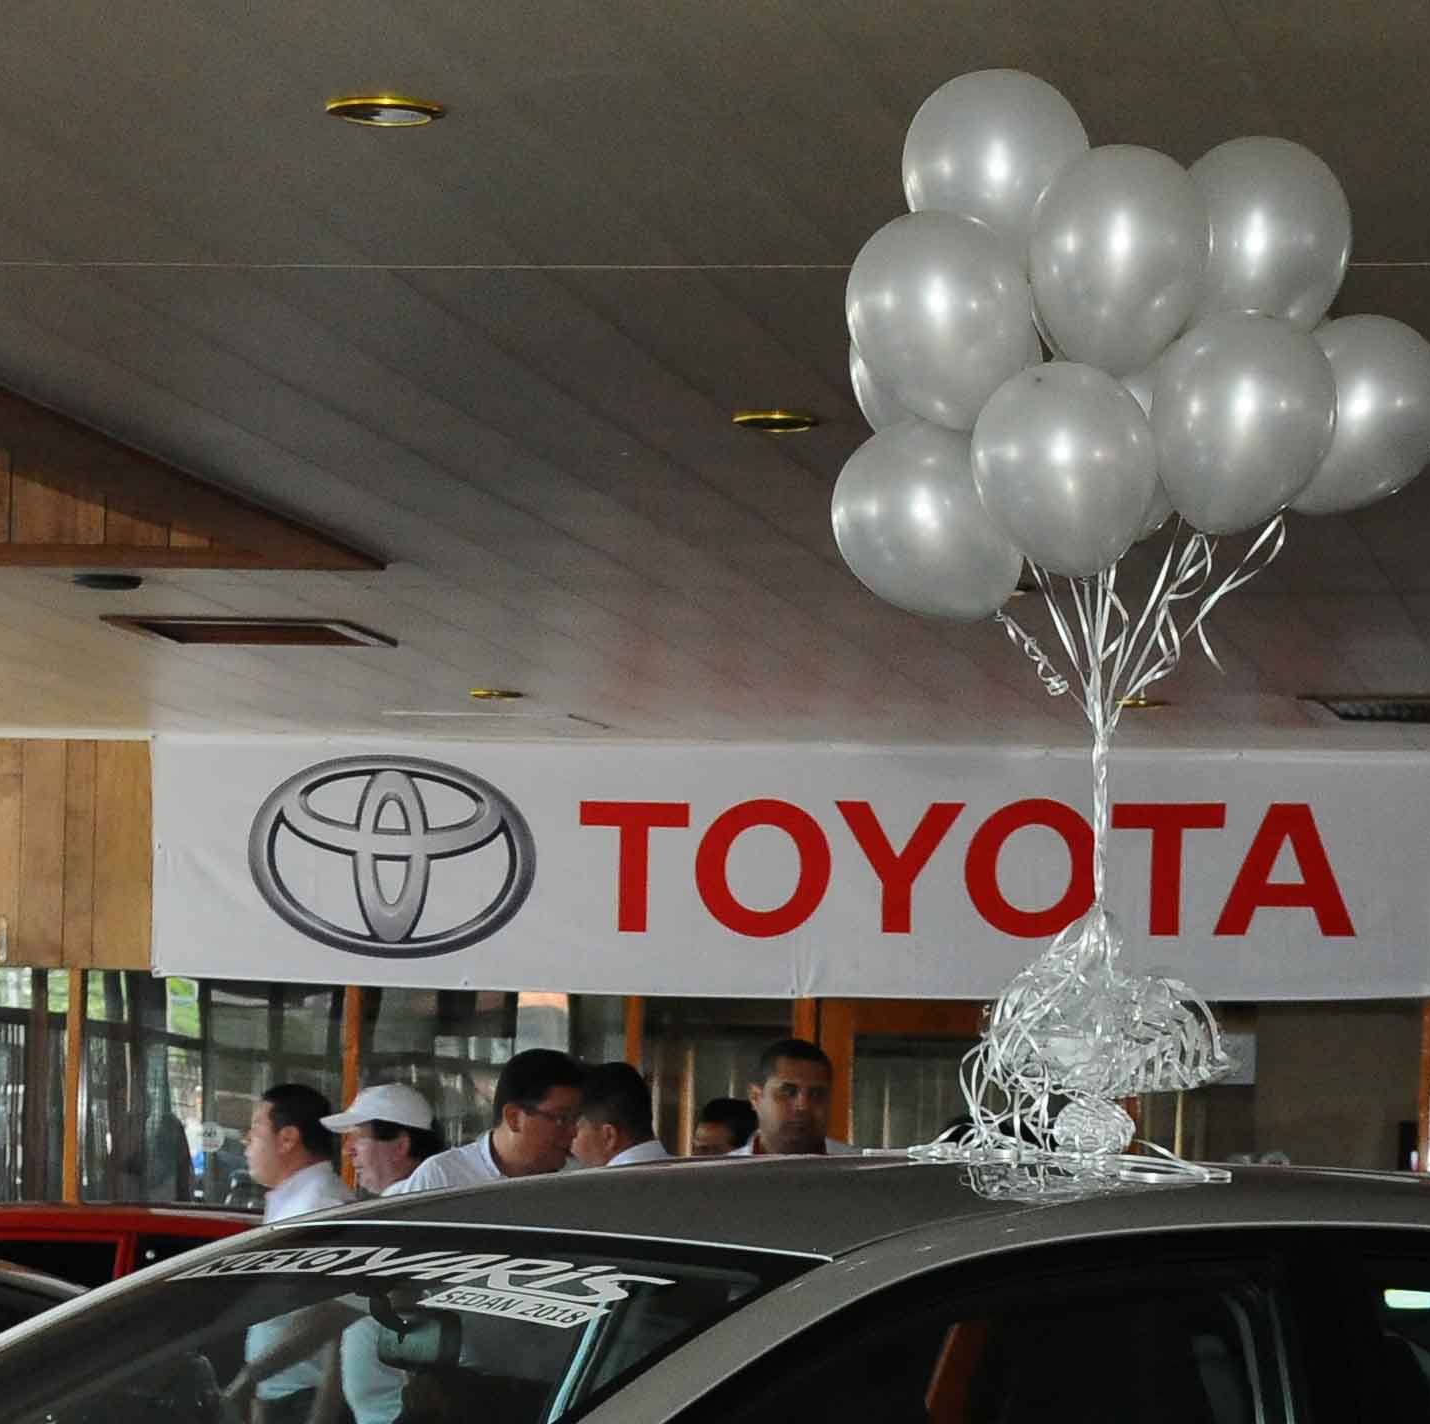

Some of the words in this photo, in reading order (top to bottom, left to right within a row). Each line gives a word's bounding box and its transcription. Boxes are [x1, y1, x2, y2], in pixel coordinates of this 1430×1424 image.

[579, 798, 1357, 938] TOYOTA
[436, 1290, 516, 1313] SEDAN
[520, 1303, 588, 1325] 2018
